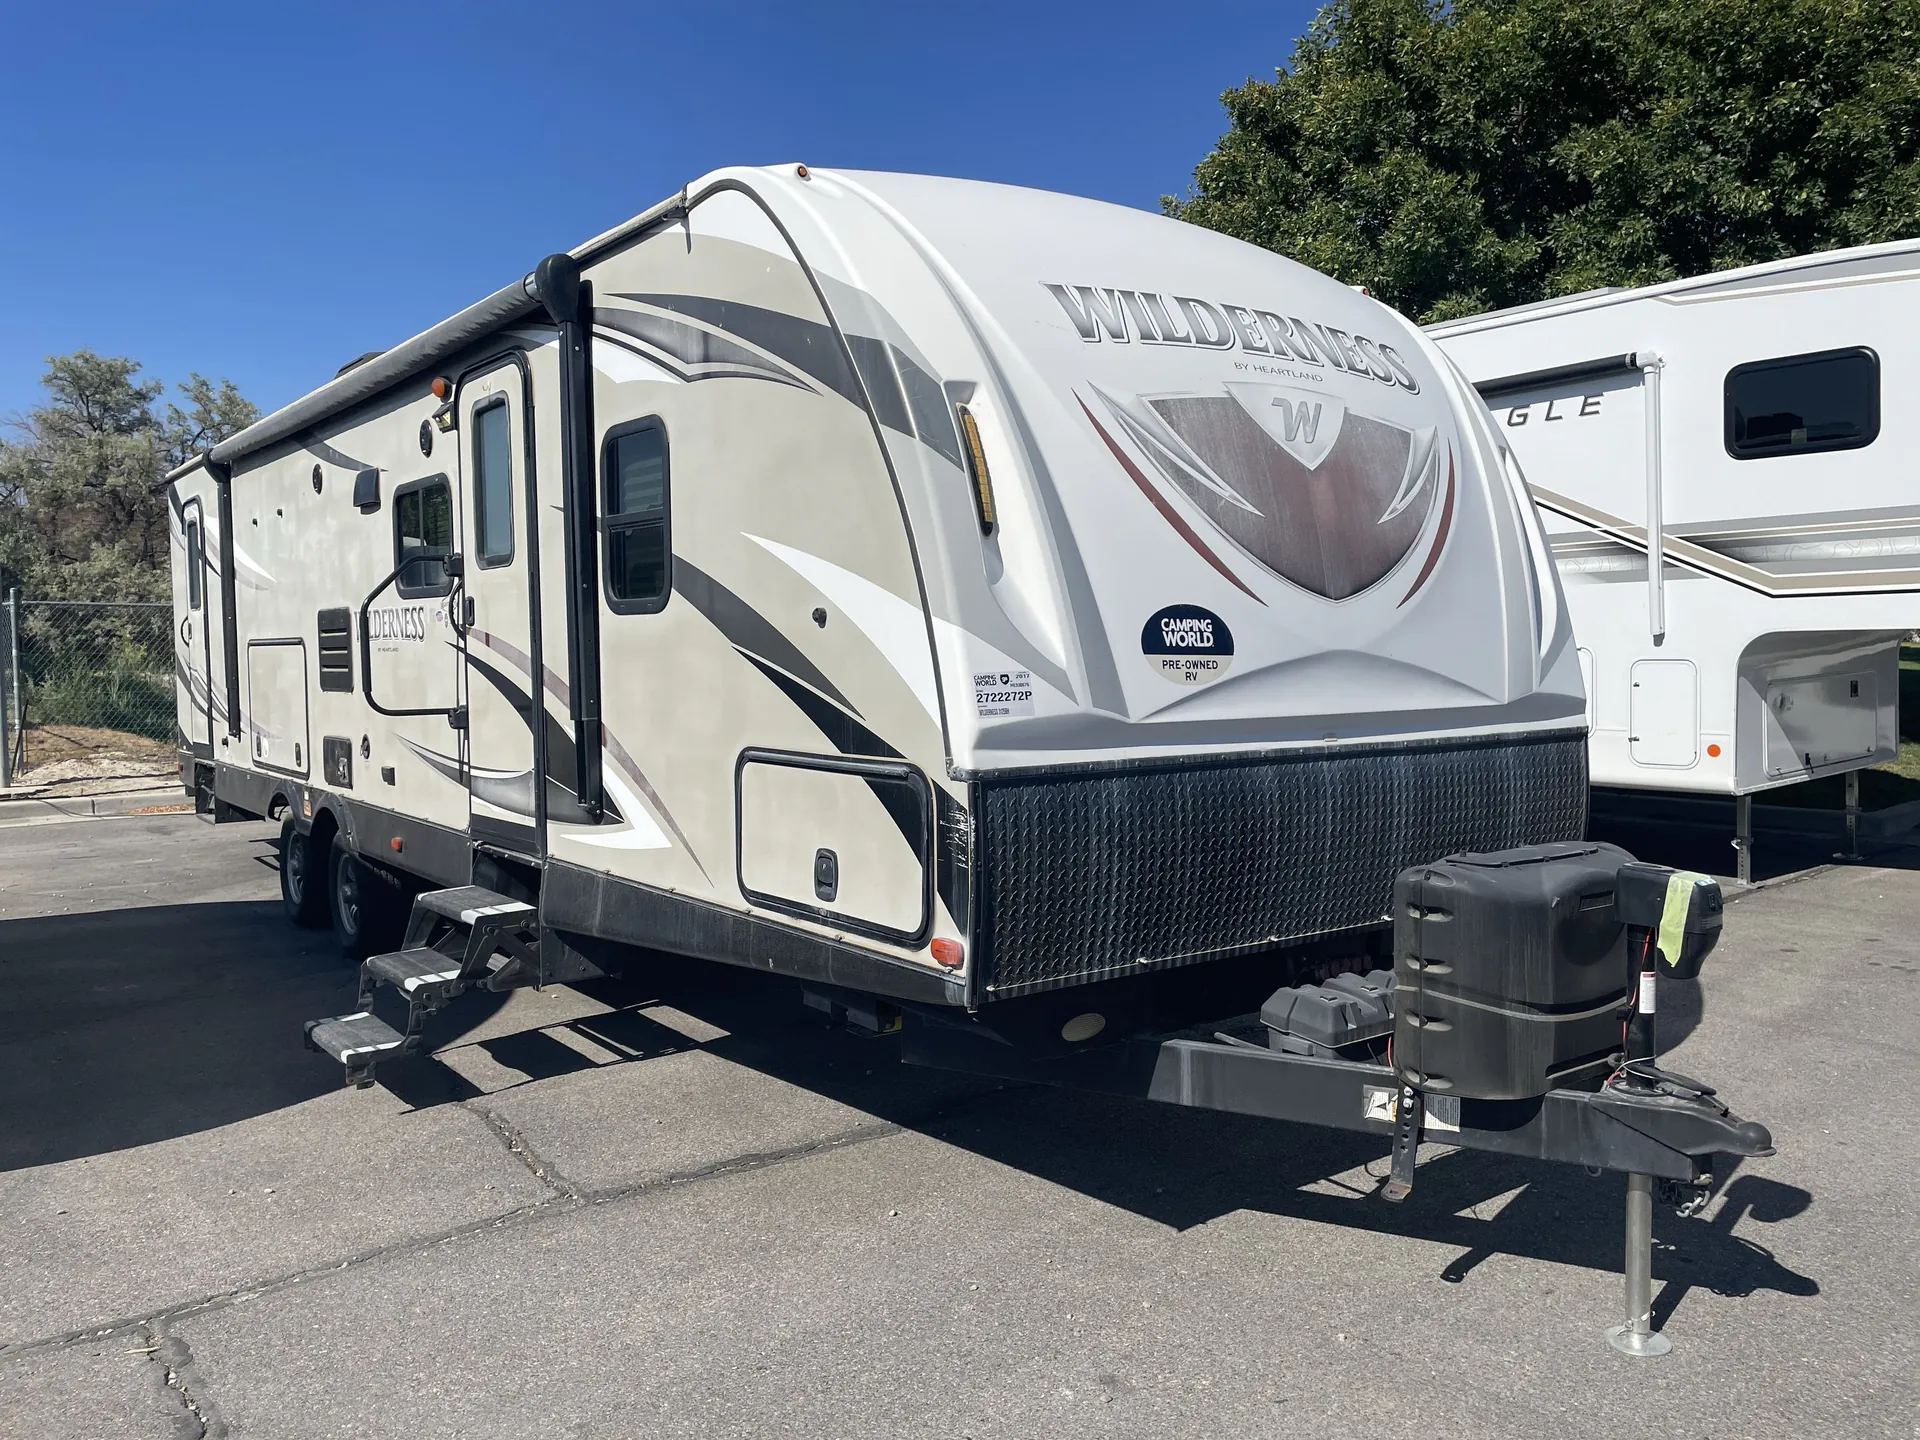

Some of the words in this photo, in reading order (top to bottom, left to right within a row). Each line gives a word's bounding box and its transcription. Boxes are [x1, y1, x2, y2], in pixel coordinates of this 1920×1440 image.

[1039, 281, 1420, 395] WILDERNESS
[1234, 362, 1249, 371] BY
[1253, 364, 1323, 382] HEARTLAND
[1271, 397, 1322, 444] W
[1161, 618, 1212, 632] CAMPING
[1162, 660, 1219, 670] PRE-OWNED
[974, 679, 997, 687] WORLD
[1185, 672, 1198, 681] RV
[976, 690, 1032, 703] 2722272P
